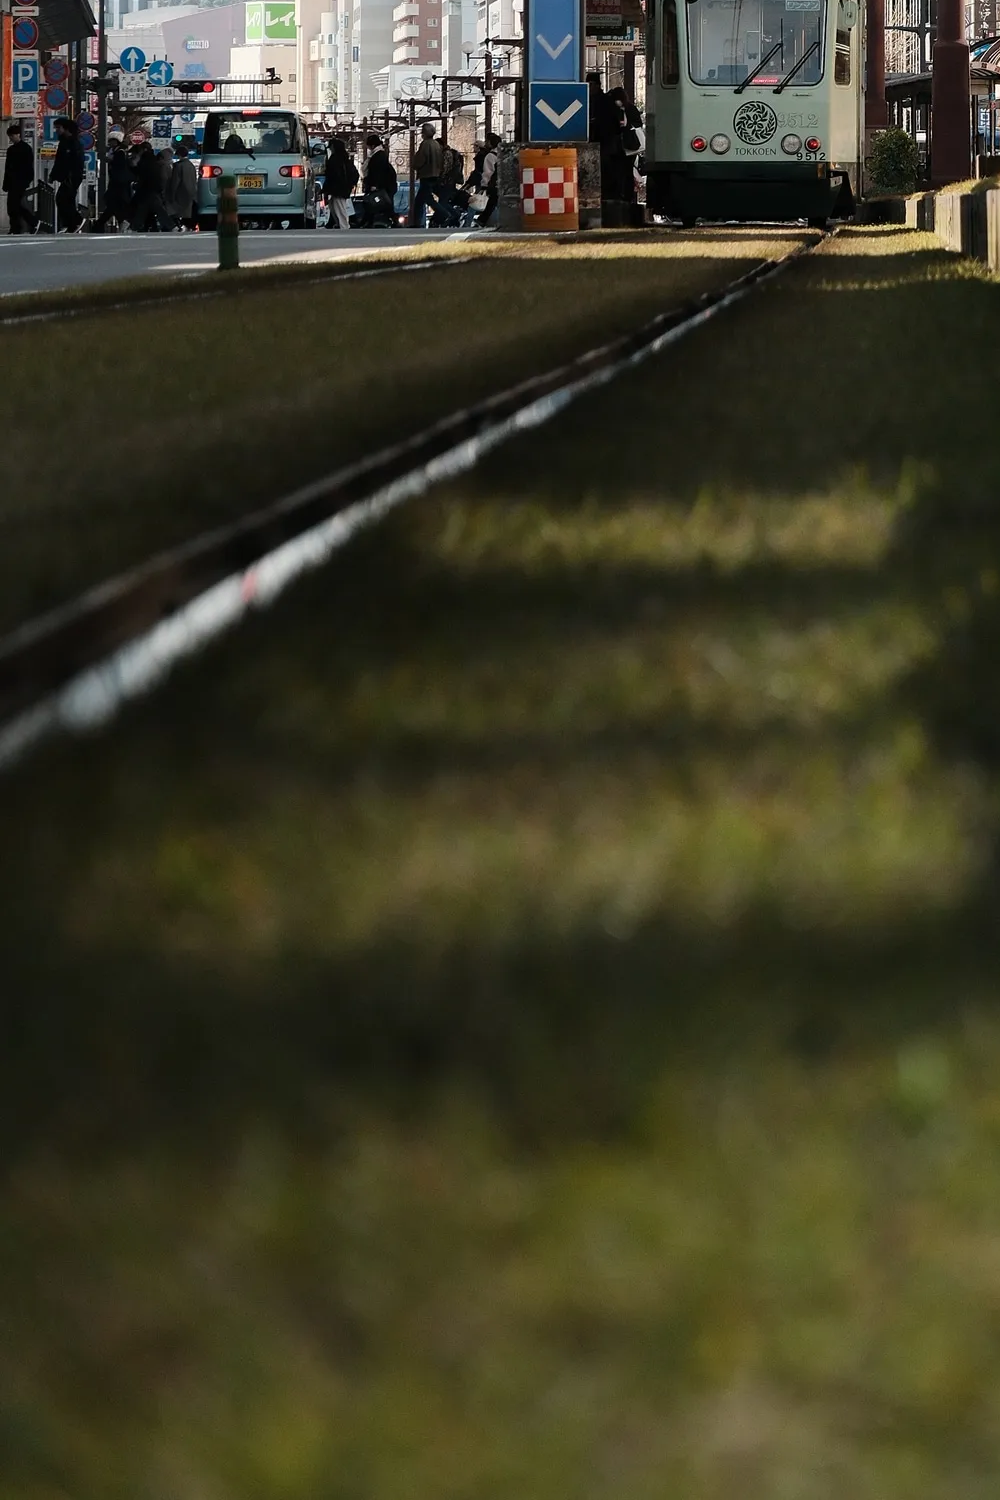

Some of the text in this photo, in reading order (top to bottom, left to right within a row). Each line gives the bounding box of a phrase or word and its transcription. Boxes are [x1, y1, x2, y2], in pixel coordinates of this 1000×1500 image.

[265, 11, 297, 26] レイ
[18, 63, 34, 90] P
[777, 113, 819, 129] 9512
[735, 148, 777, 156] TOKKOEN
[796, 152, 826, 161] 9512
